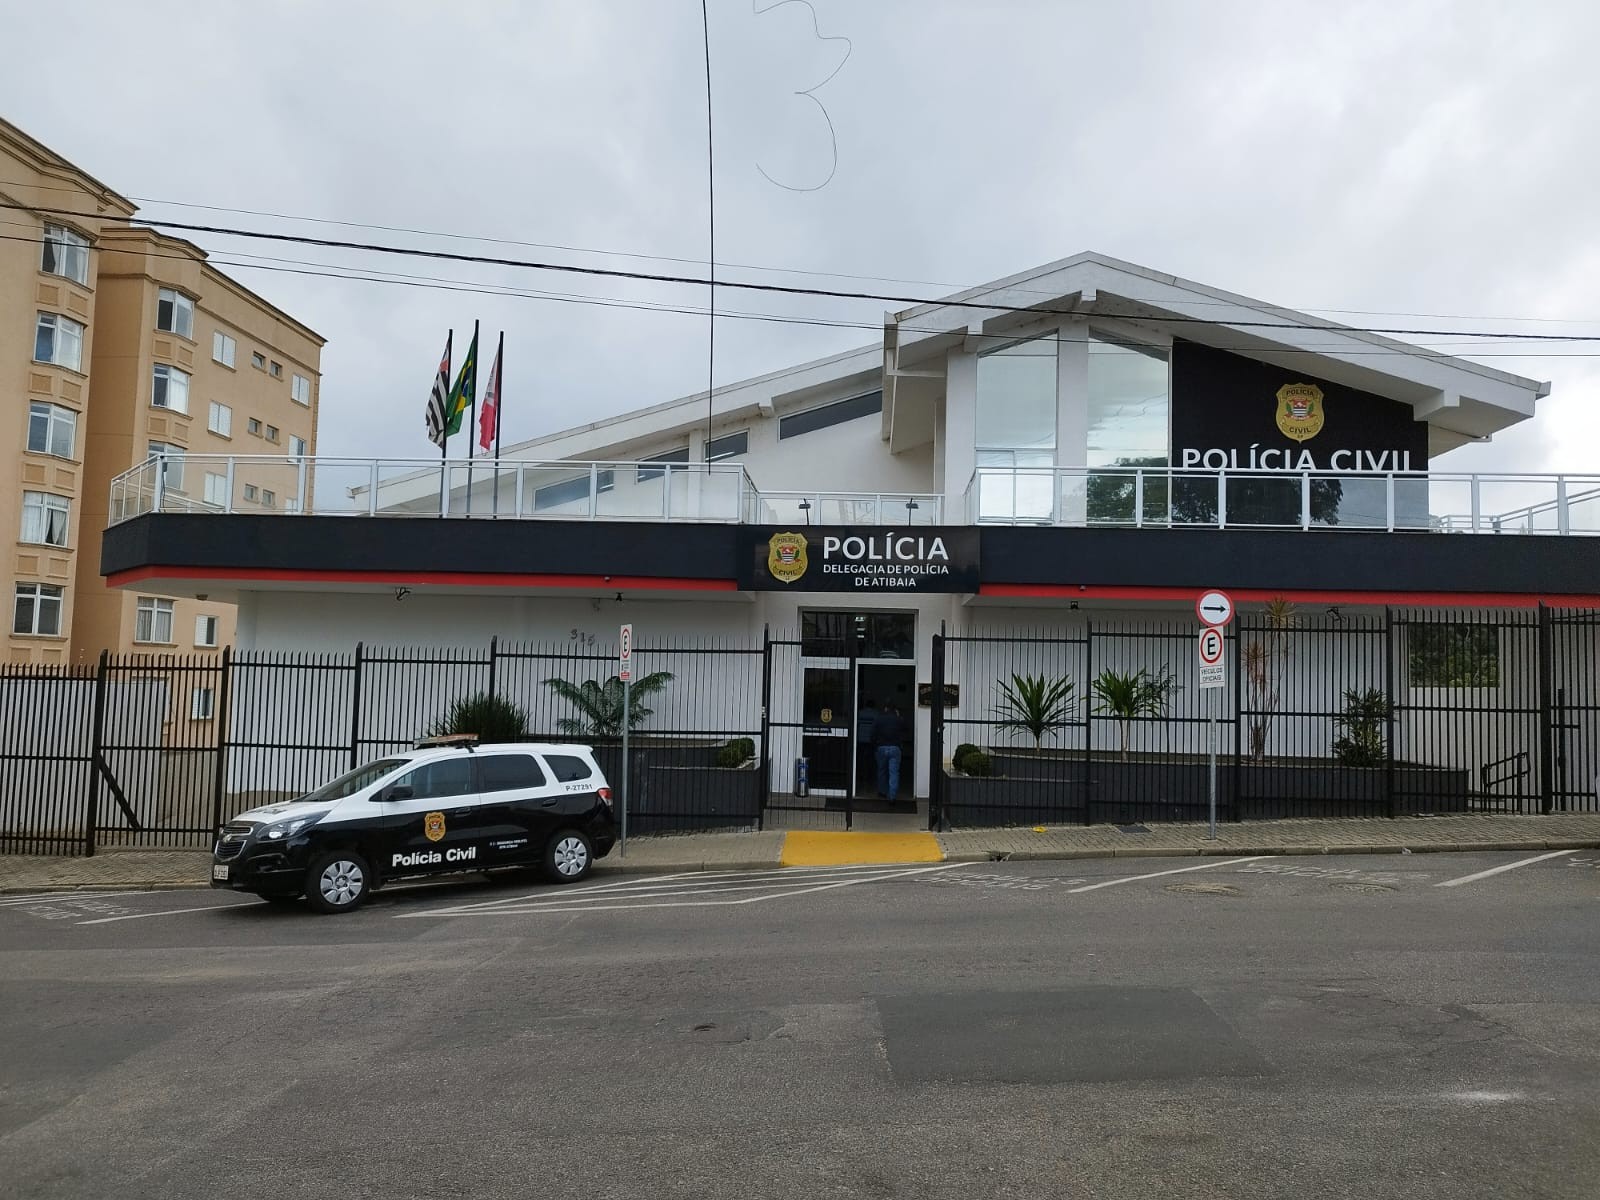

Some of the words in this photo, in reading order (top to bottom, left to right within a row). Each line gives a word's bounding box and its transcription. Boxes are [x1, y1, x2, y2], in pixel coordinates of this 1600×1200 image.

[1182, 443, 1317, 471] POLÍCIA
[823, 532, 949, 560] POLÍCIA
[823, 564, 885, 574] DELEGACIA
[888, 565, 901, 574] DE
[903, 563, 949, 575] POLÍCIA
[855, 577, 869, 586] DE
[871, 577, 916, 587] ATIBAIA
[1207, 637, 1216, 655] E
[392, 849, 442, 867] Polícia
[446, 846, 476, 862] Civil
